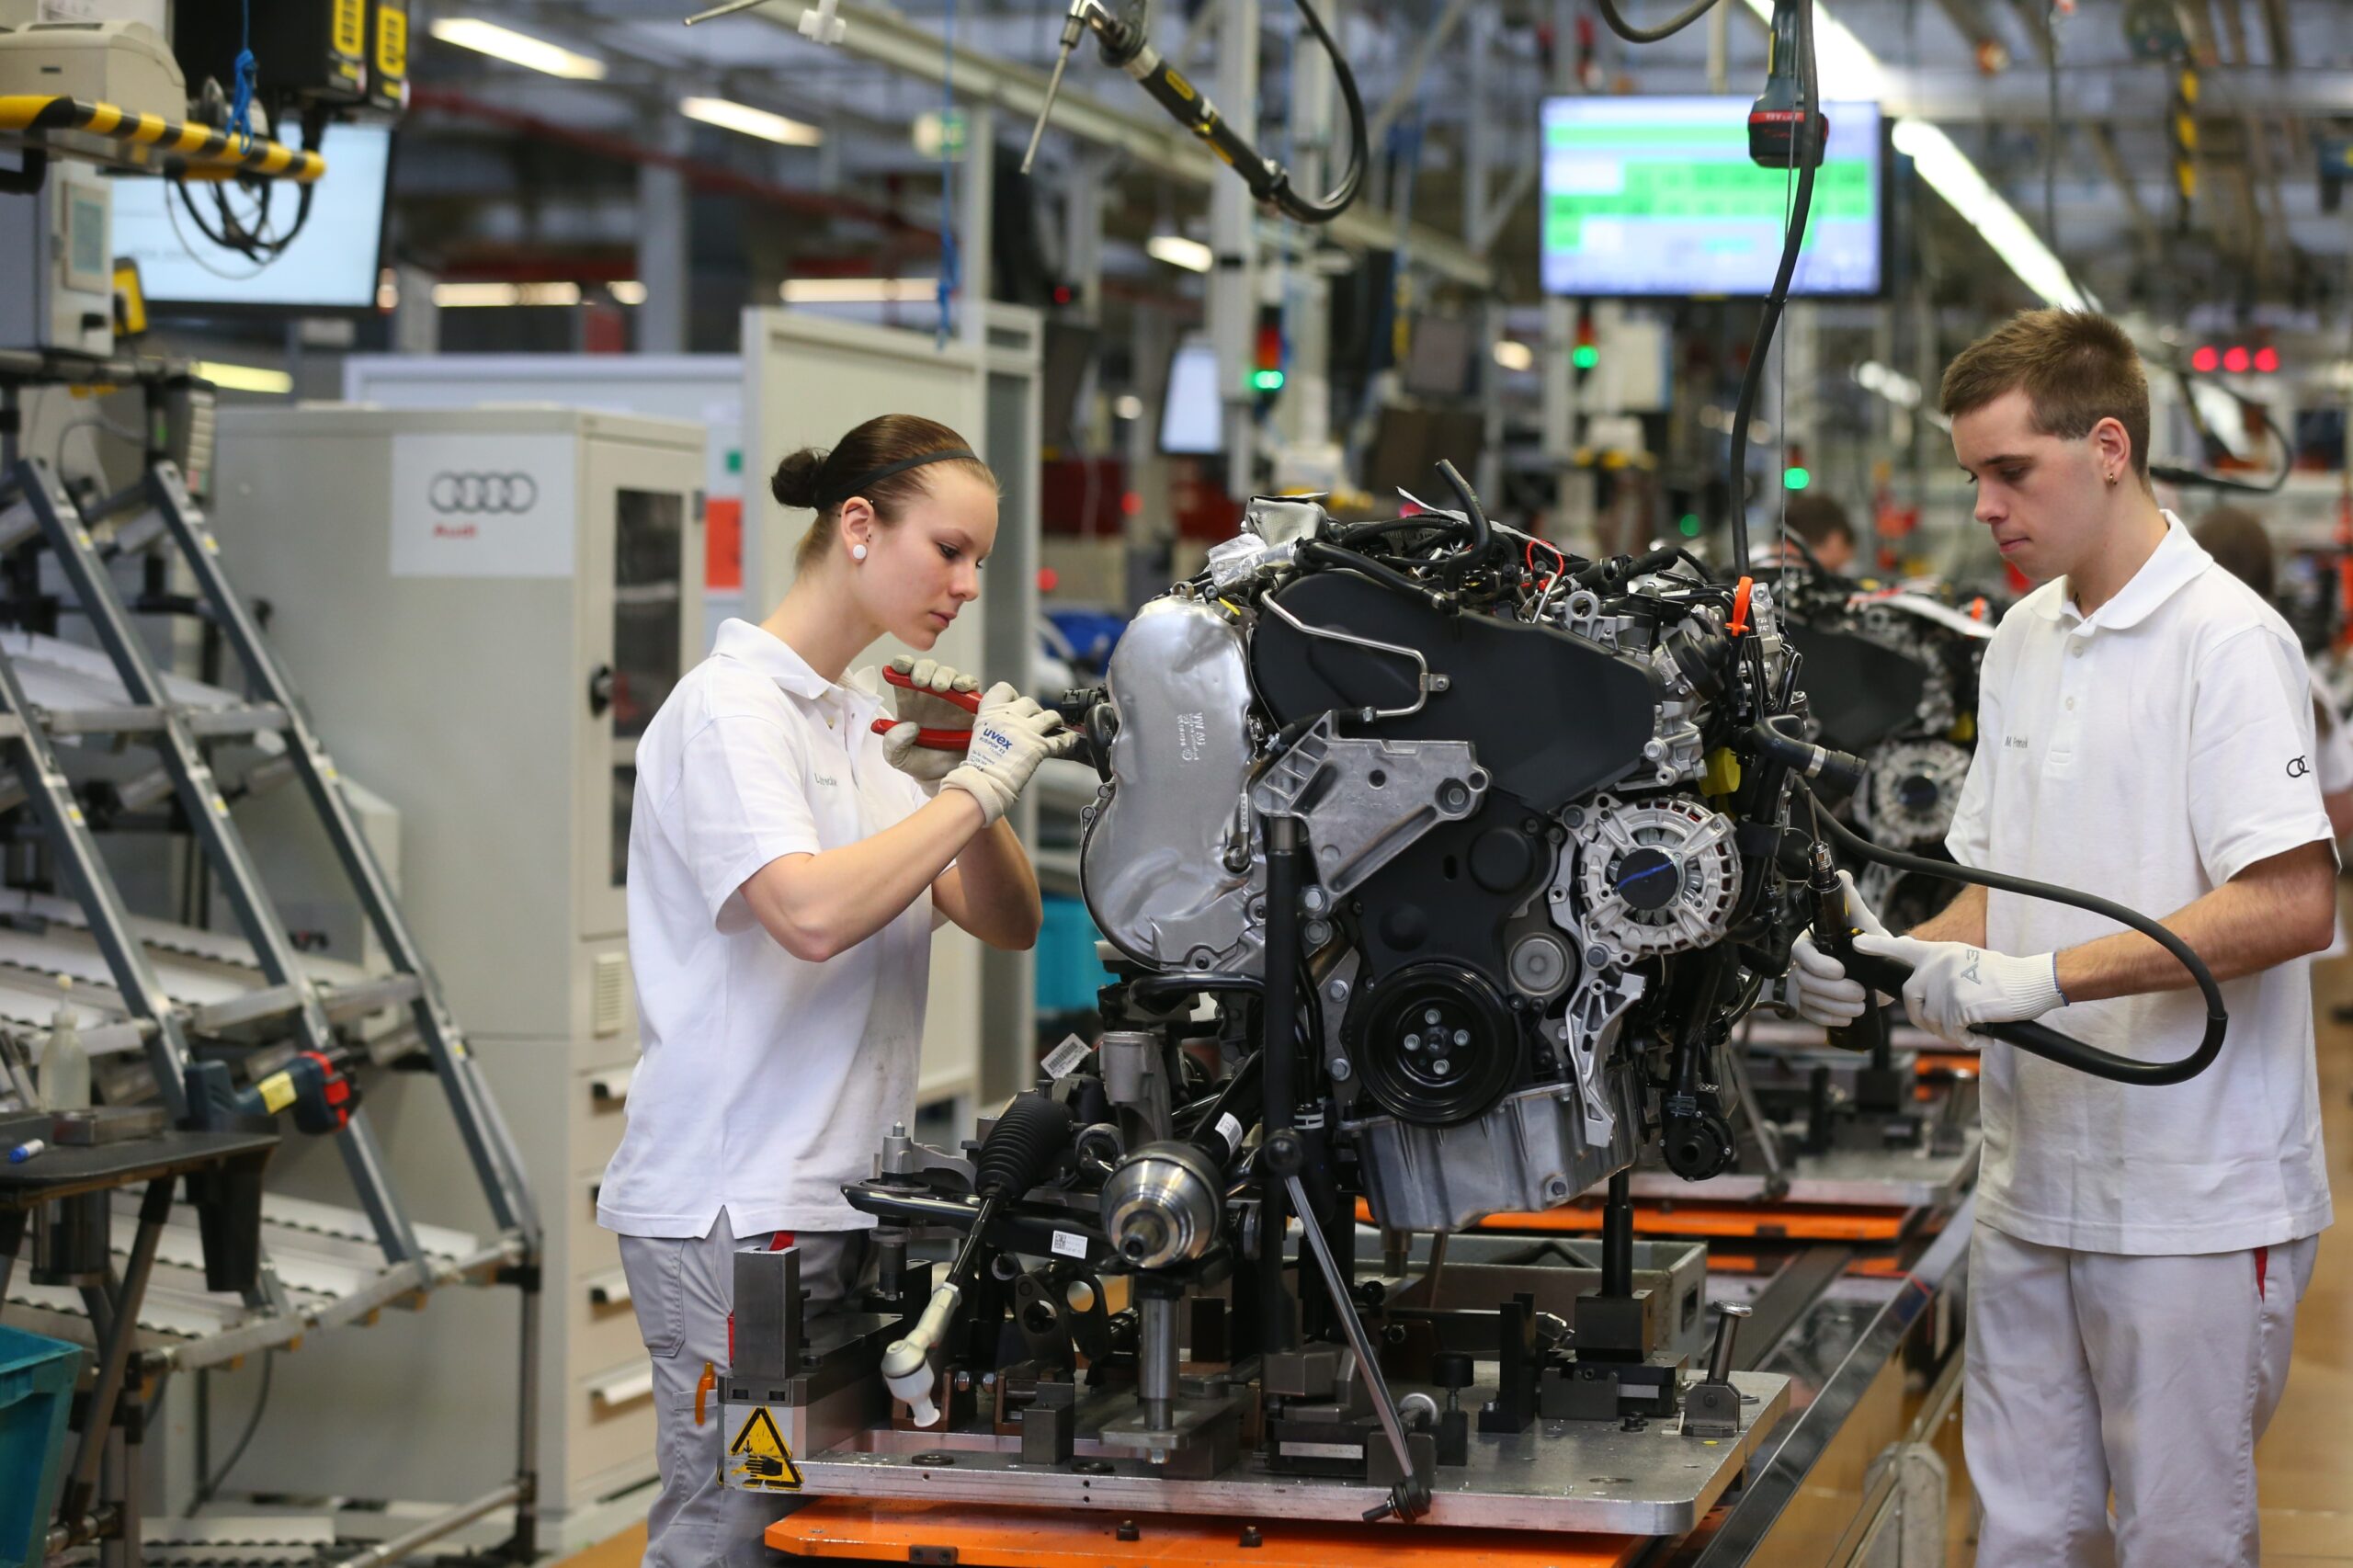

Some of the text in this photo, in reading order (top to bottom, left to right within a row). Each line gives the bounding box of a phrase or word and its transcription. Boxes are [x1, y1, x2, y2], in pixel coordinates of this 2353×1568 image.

[433, 522, 478, 540] Audi
[983, 727, 1013, 750] uvex
[1960, 949, 1982, 985] A3
